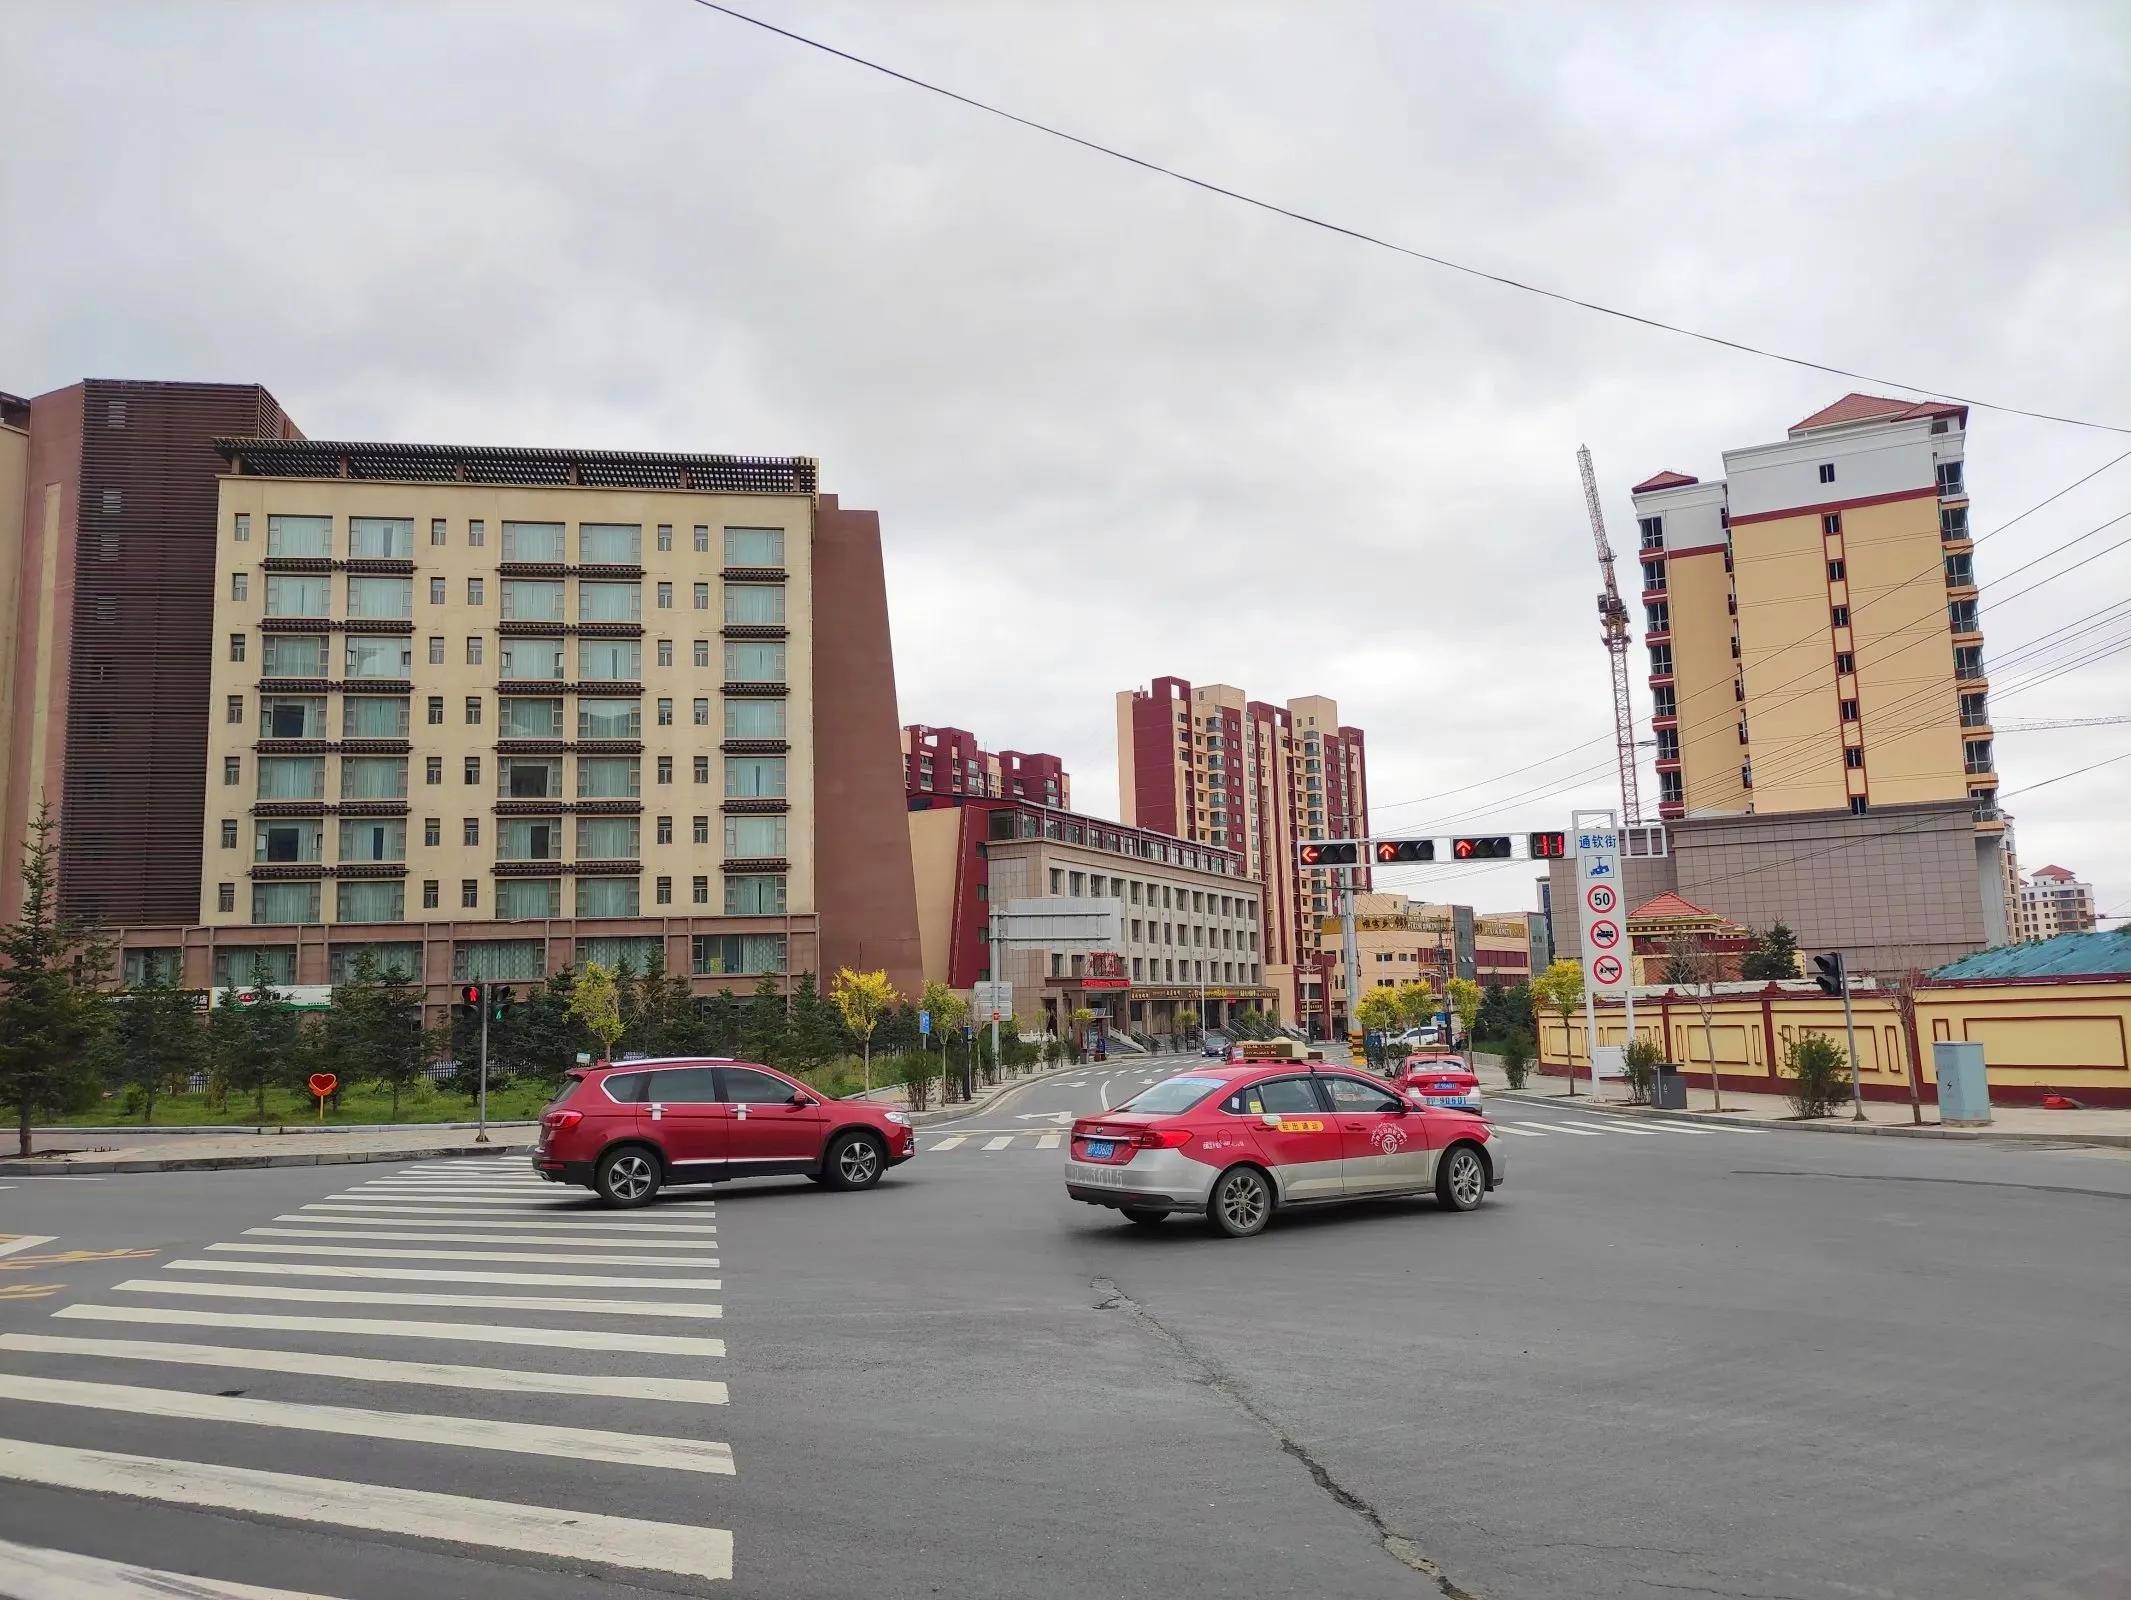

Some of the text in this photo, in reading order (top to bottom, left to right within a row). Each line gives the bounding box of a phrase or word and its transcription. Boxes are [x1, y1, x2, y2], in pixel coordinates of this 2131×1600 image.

[1579, 834, 1617, 849] 通钦街
[1594, 892, 1611, 906] 50
